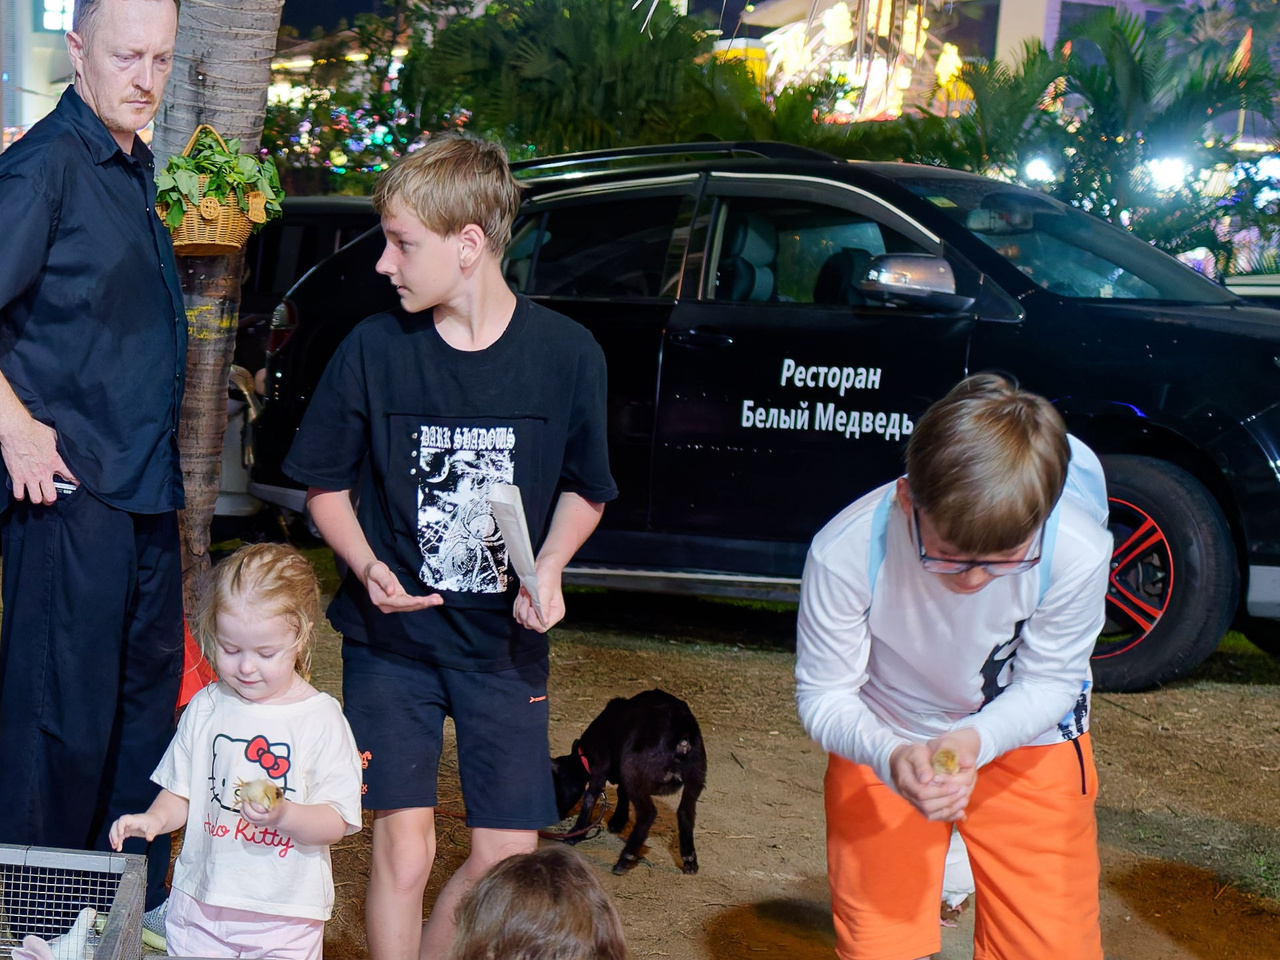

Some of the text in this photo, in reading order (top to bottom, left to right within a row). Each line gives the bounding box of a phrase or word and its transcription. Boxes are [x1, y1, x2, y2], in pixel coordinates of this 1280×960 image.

[780, 358, 882, 397] Ресторан
[420, 425, 452, 450] DARK
[741, 399, 915, 442] Белый Медведь
[234, 817, 295, 859] Kitty
